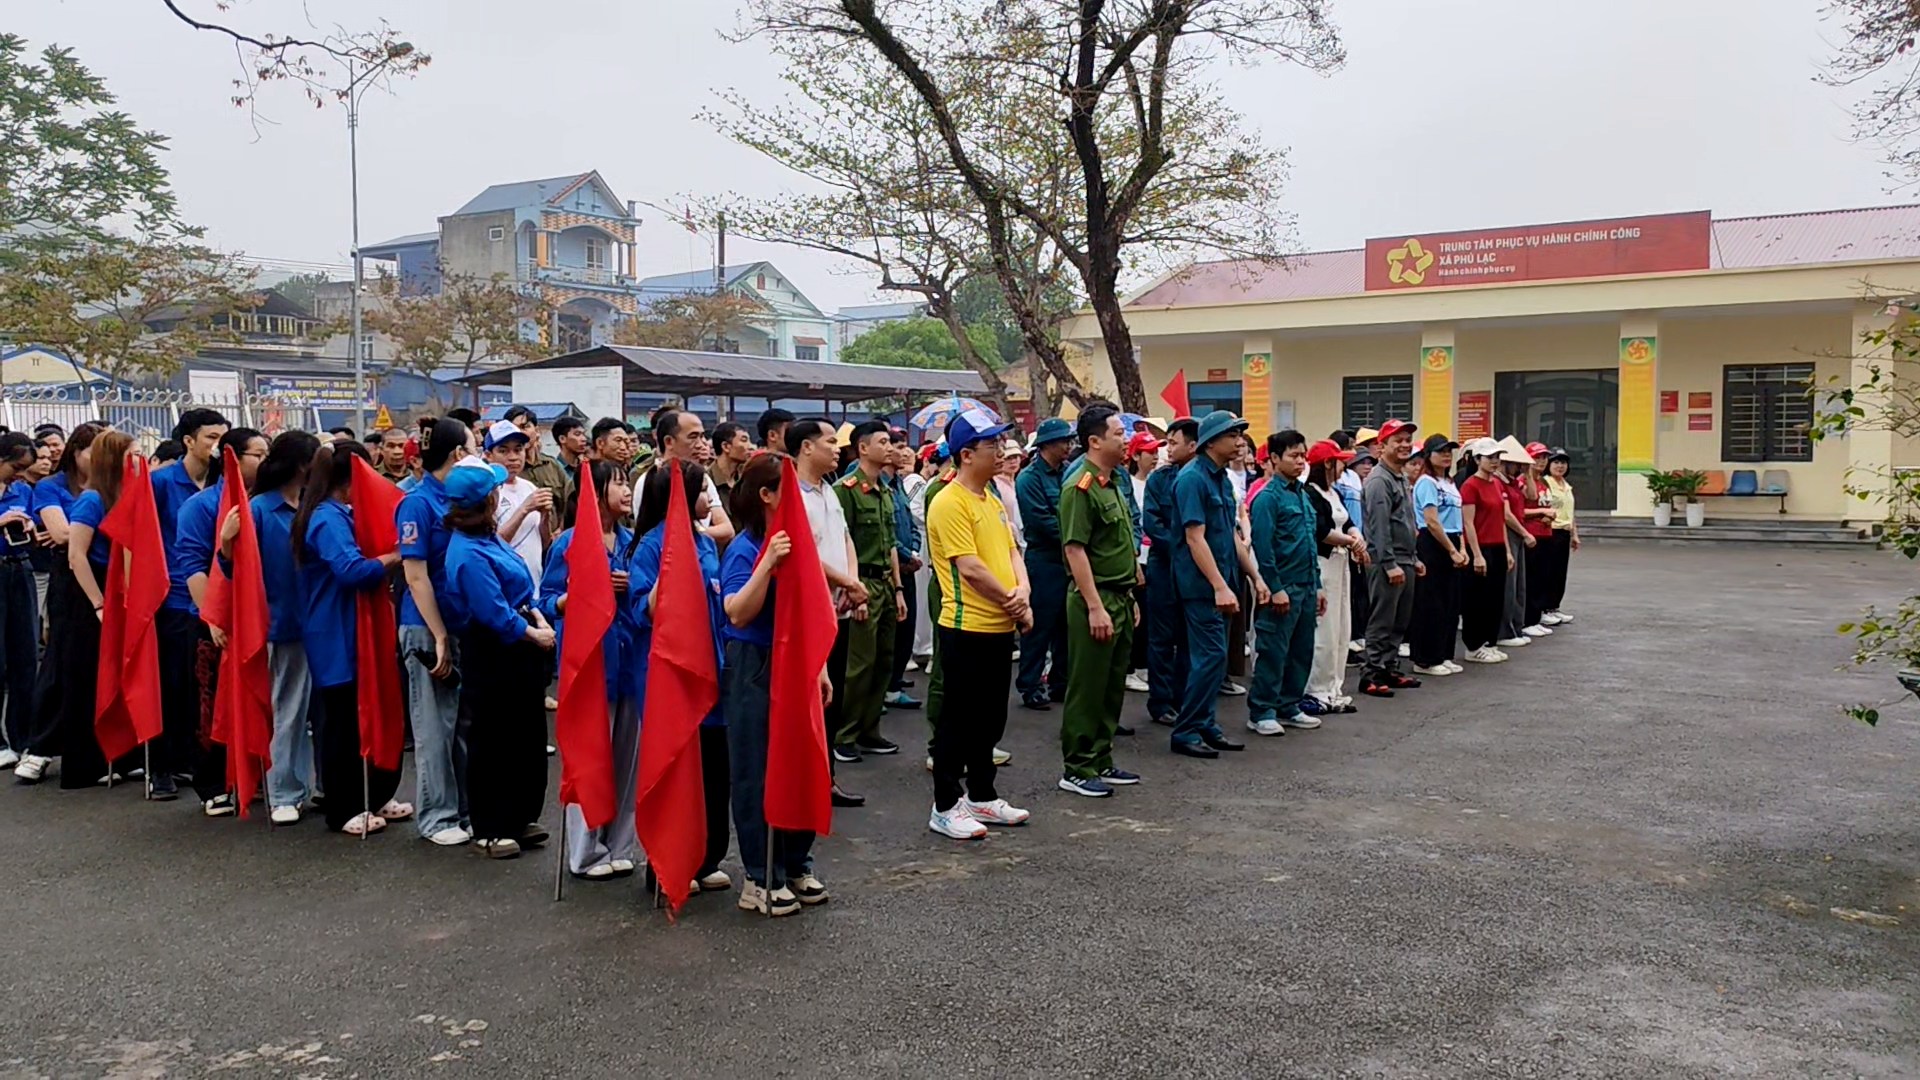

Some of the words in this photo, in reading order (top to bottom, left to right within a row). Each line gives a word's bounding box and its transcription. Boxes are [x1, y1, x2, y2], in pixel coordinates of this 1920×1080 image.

[1439, 241, 1472, 253] TRUNG
[1473, 238, 1493, 250] TÂM
[1495, 237, 1524, 249] PHỤC
[1525, 235, 1540, 248] VỤ
[1542, 232, 1571, 245] HÀNH
[1573, 229, 1608, 242] CHÍNH
[1610, 226, 1641, 240] CÔNG
[1476, 252, 1497, 265] LẠC
